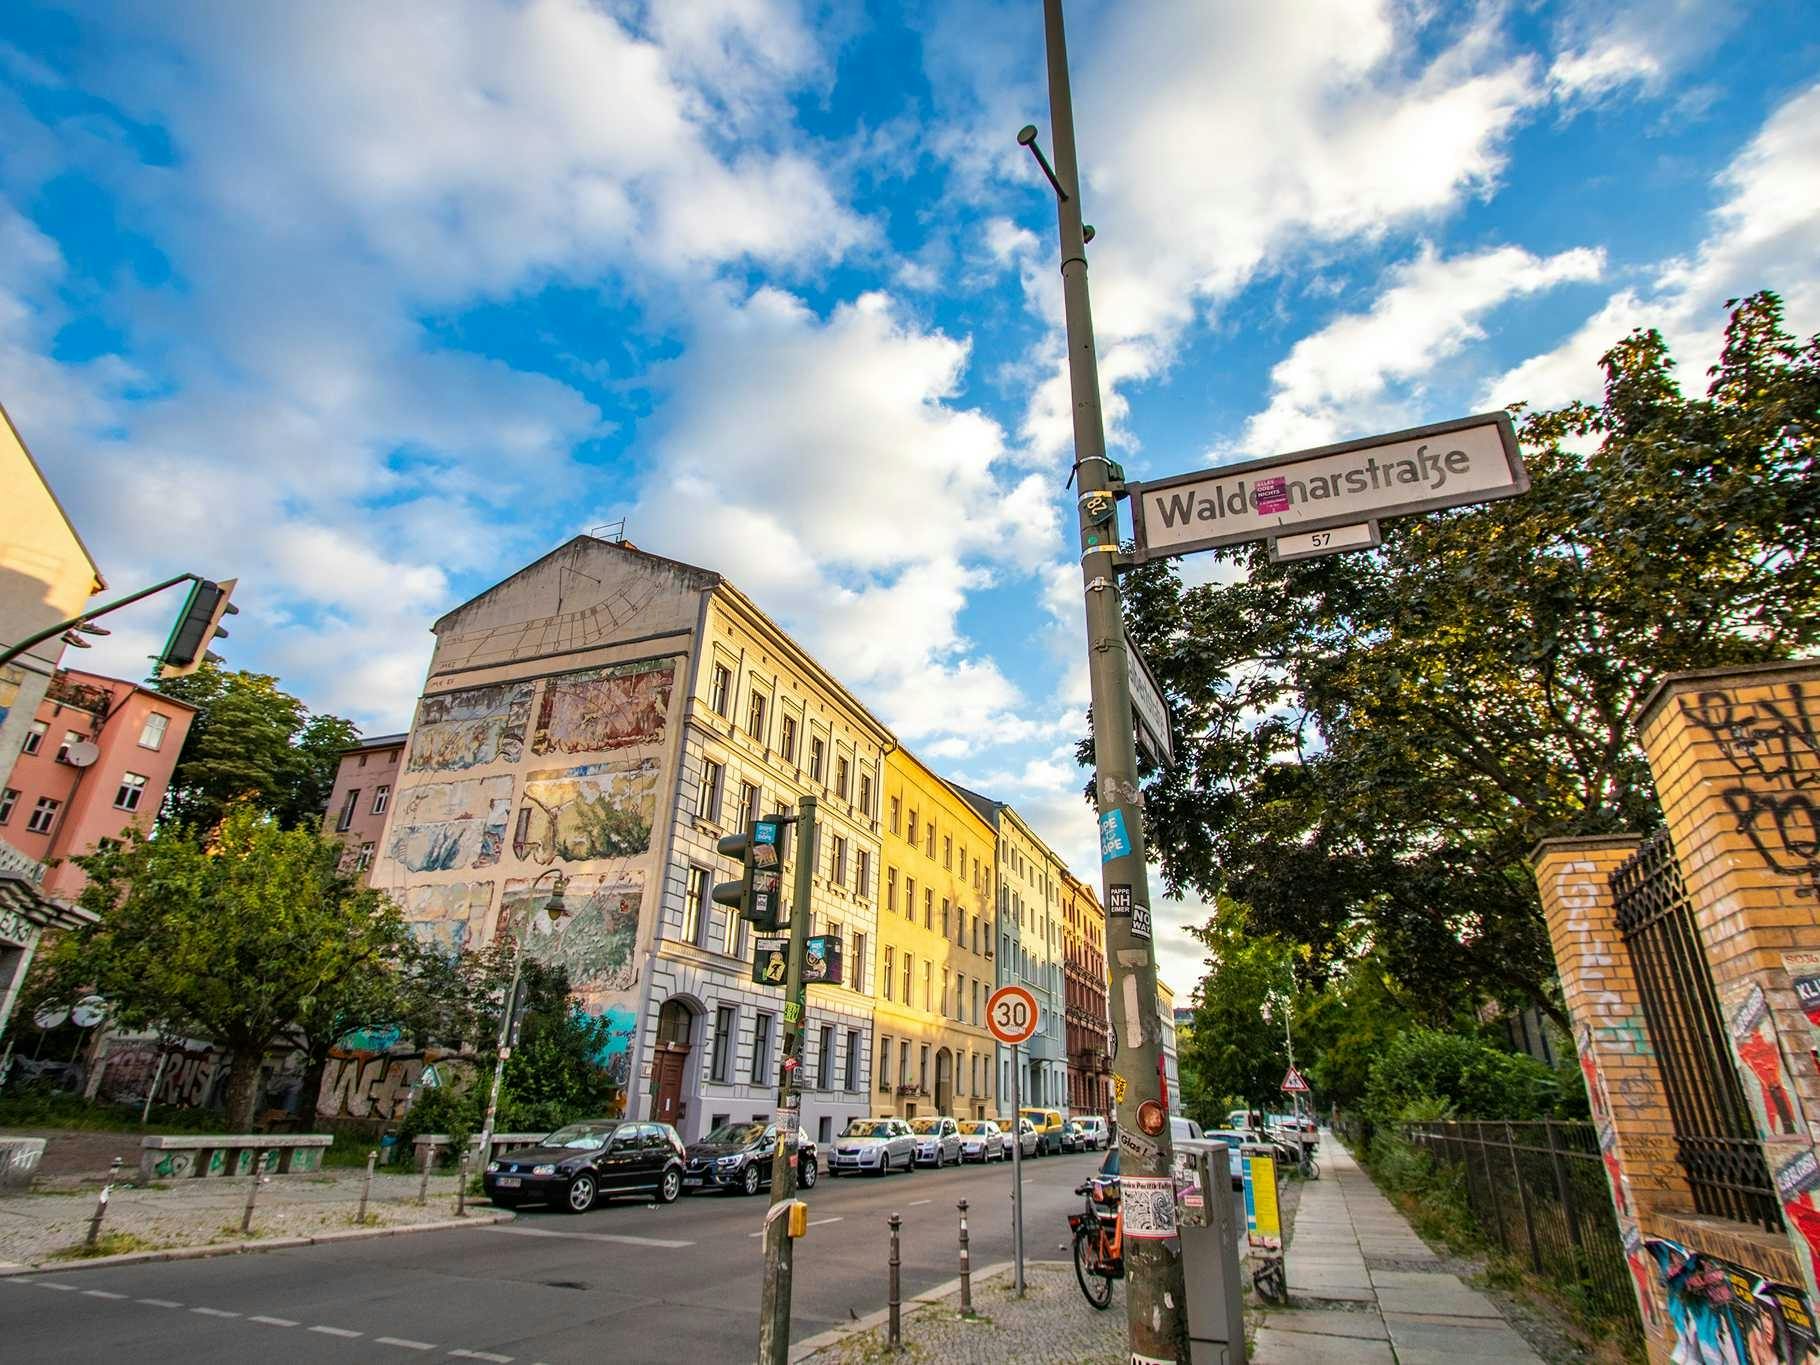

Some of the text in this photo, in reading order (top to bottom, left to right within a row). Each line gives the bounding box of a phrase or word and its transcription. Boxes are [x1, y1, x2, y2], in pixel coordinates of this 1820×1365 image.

[1312, 533, 1331, 547] 57
[1111, 894, 1130, 907] NH
[1133, 909, 1151, 926] NO
[1132, 920, 1151, 933] WAY
[998, 1002, 1027, 1027] 30
[1121, 1135, 1141, 1153] Glas
